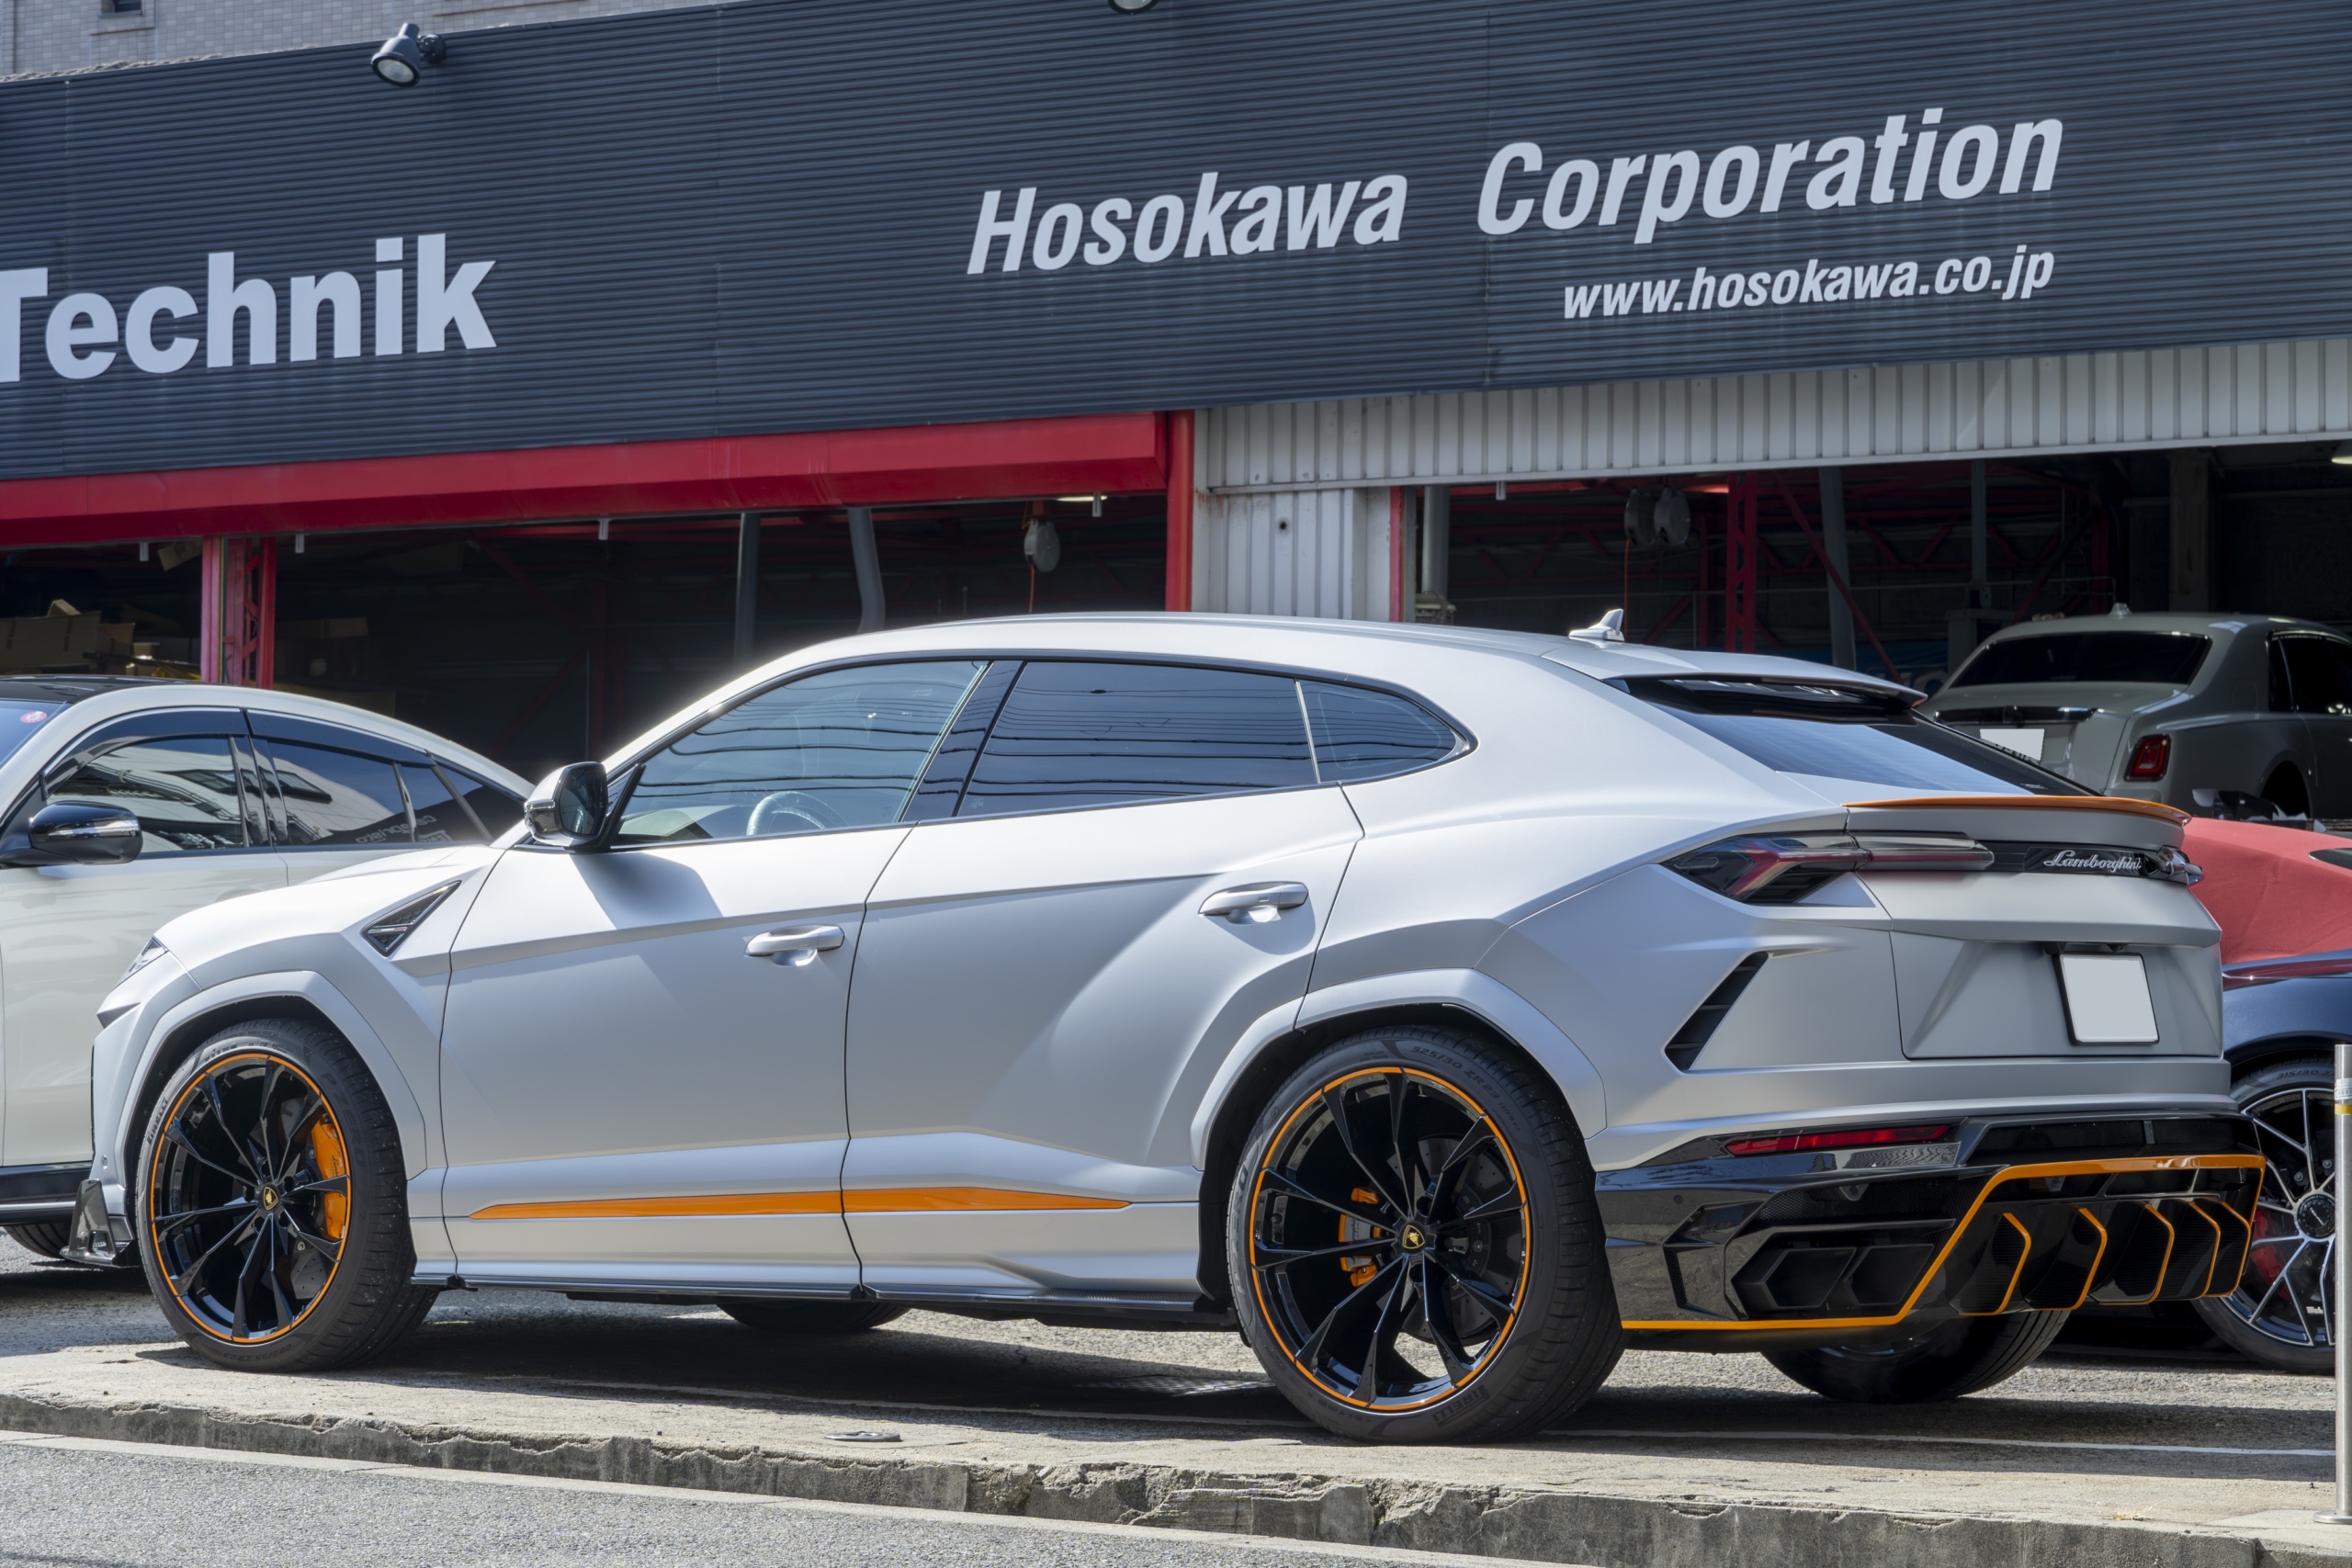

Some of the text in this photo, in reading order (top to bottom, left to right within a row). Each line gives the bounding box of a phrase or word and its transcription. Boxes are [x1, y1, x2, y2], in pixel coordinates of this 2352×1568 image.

[967, 107, 2064, 275] Hosokawa Corporation
[0, 232, 497, 383] Technik
[1564, 244, 2054, 319] www.hosokawa.co.jp
[2043, 849, 2142, 874] Lamborghini
[1409, 1045, 1464, 1069] 325/30
[1463, 1069, 1500, 1100] ZR23
[2278, 1068, 2319, 1078] 315/30
[1431, 1383, 1490, 1428] PIRELLI
